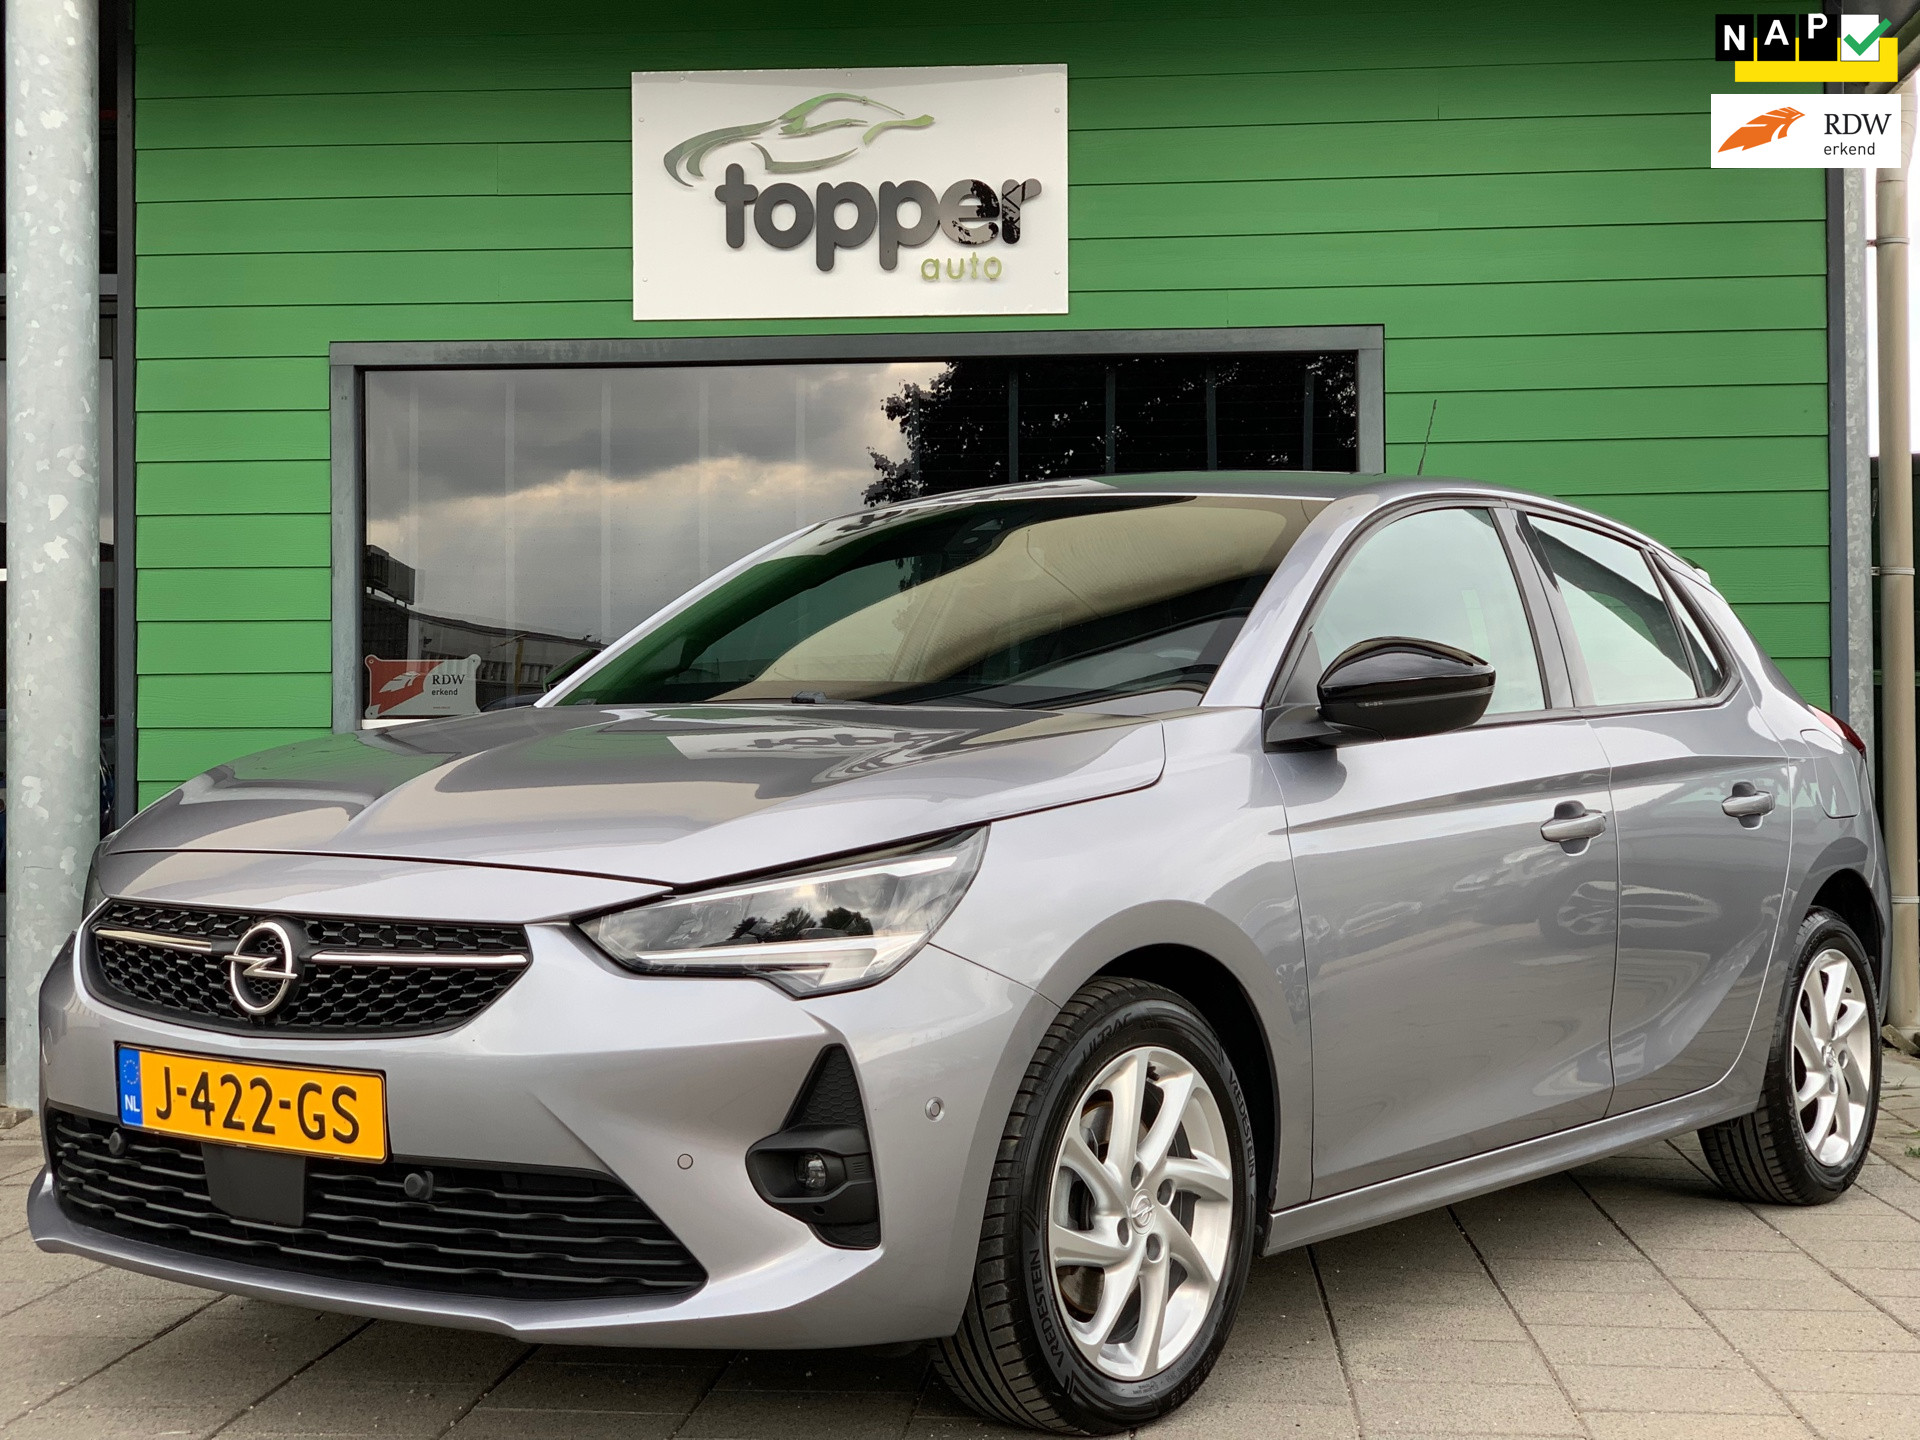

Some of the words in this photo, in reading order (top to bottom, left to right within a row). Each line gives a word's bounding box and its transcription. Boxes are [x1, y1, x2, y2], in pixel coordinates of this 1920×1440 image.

[714, 162, 1043, 272] topper
[921, 251, 1002, 281] auto
[431, 688, 458, 696] erkend
[432, 674, 465, 685] RDW
[124, 1093, 140, 1112] NL
[155, 1066, 360, 1144] J-422-GS
[1229, 1068, 1256, 1178] VREDESTEIN
[1029, 1248, 1065, 1367] VREDESTEIN
